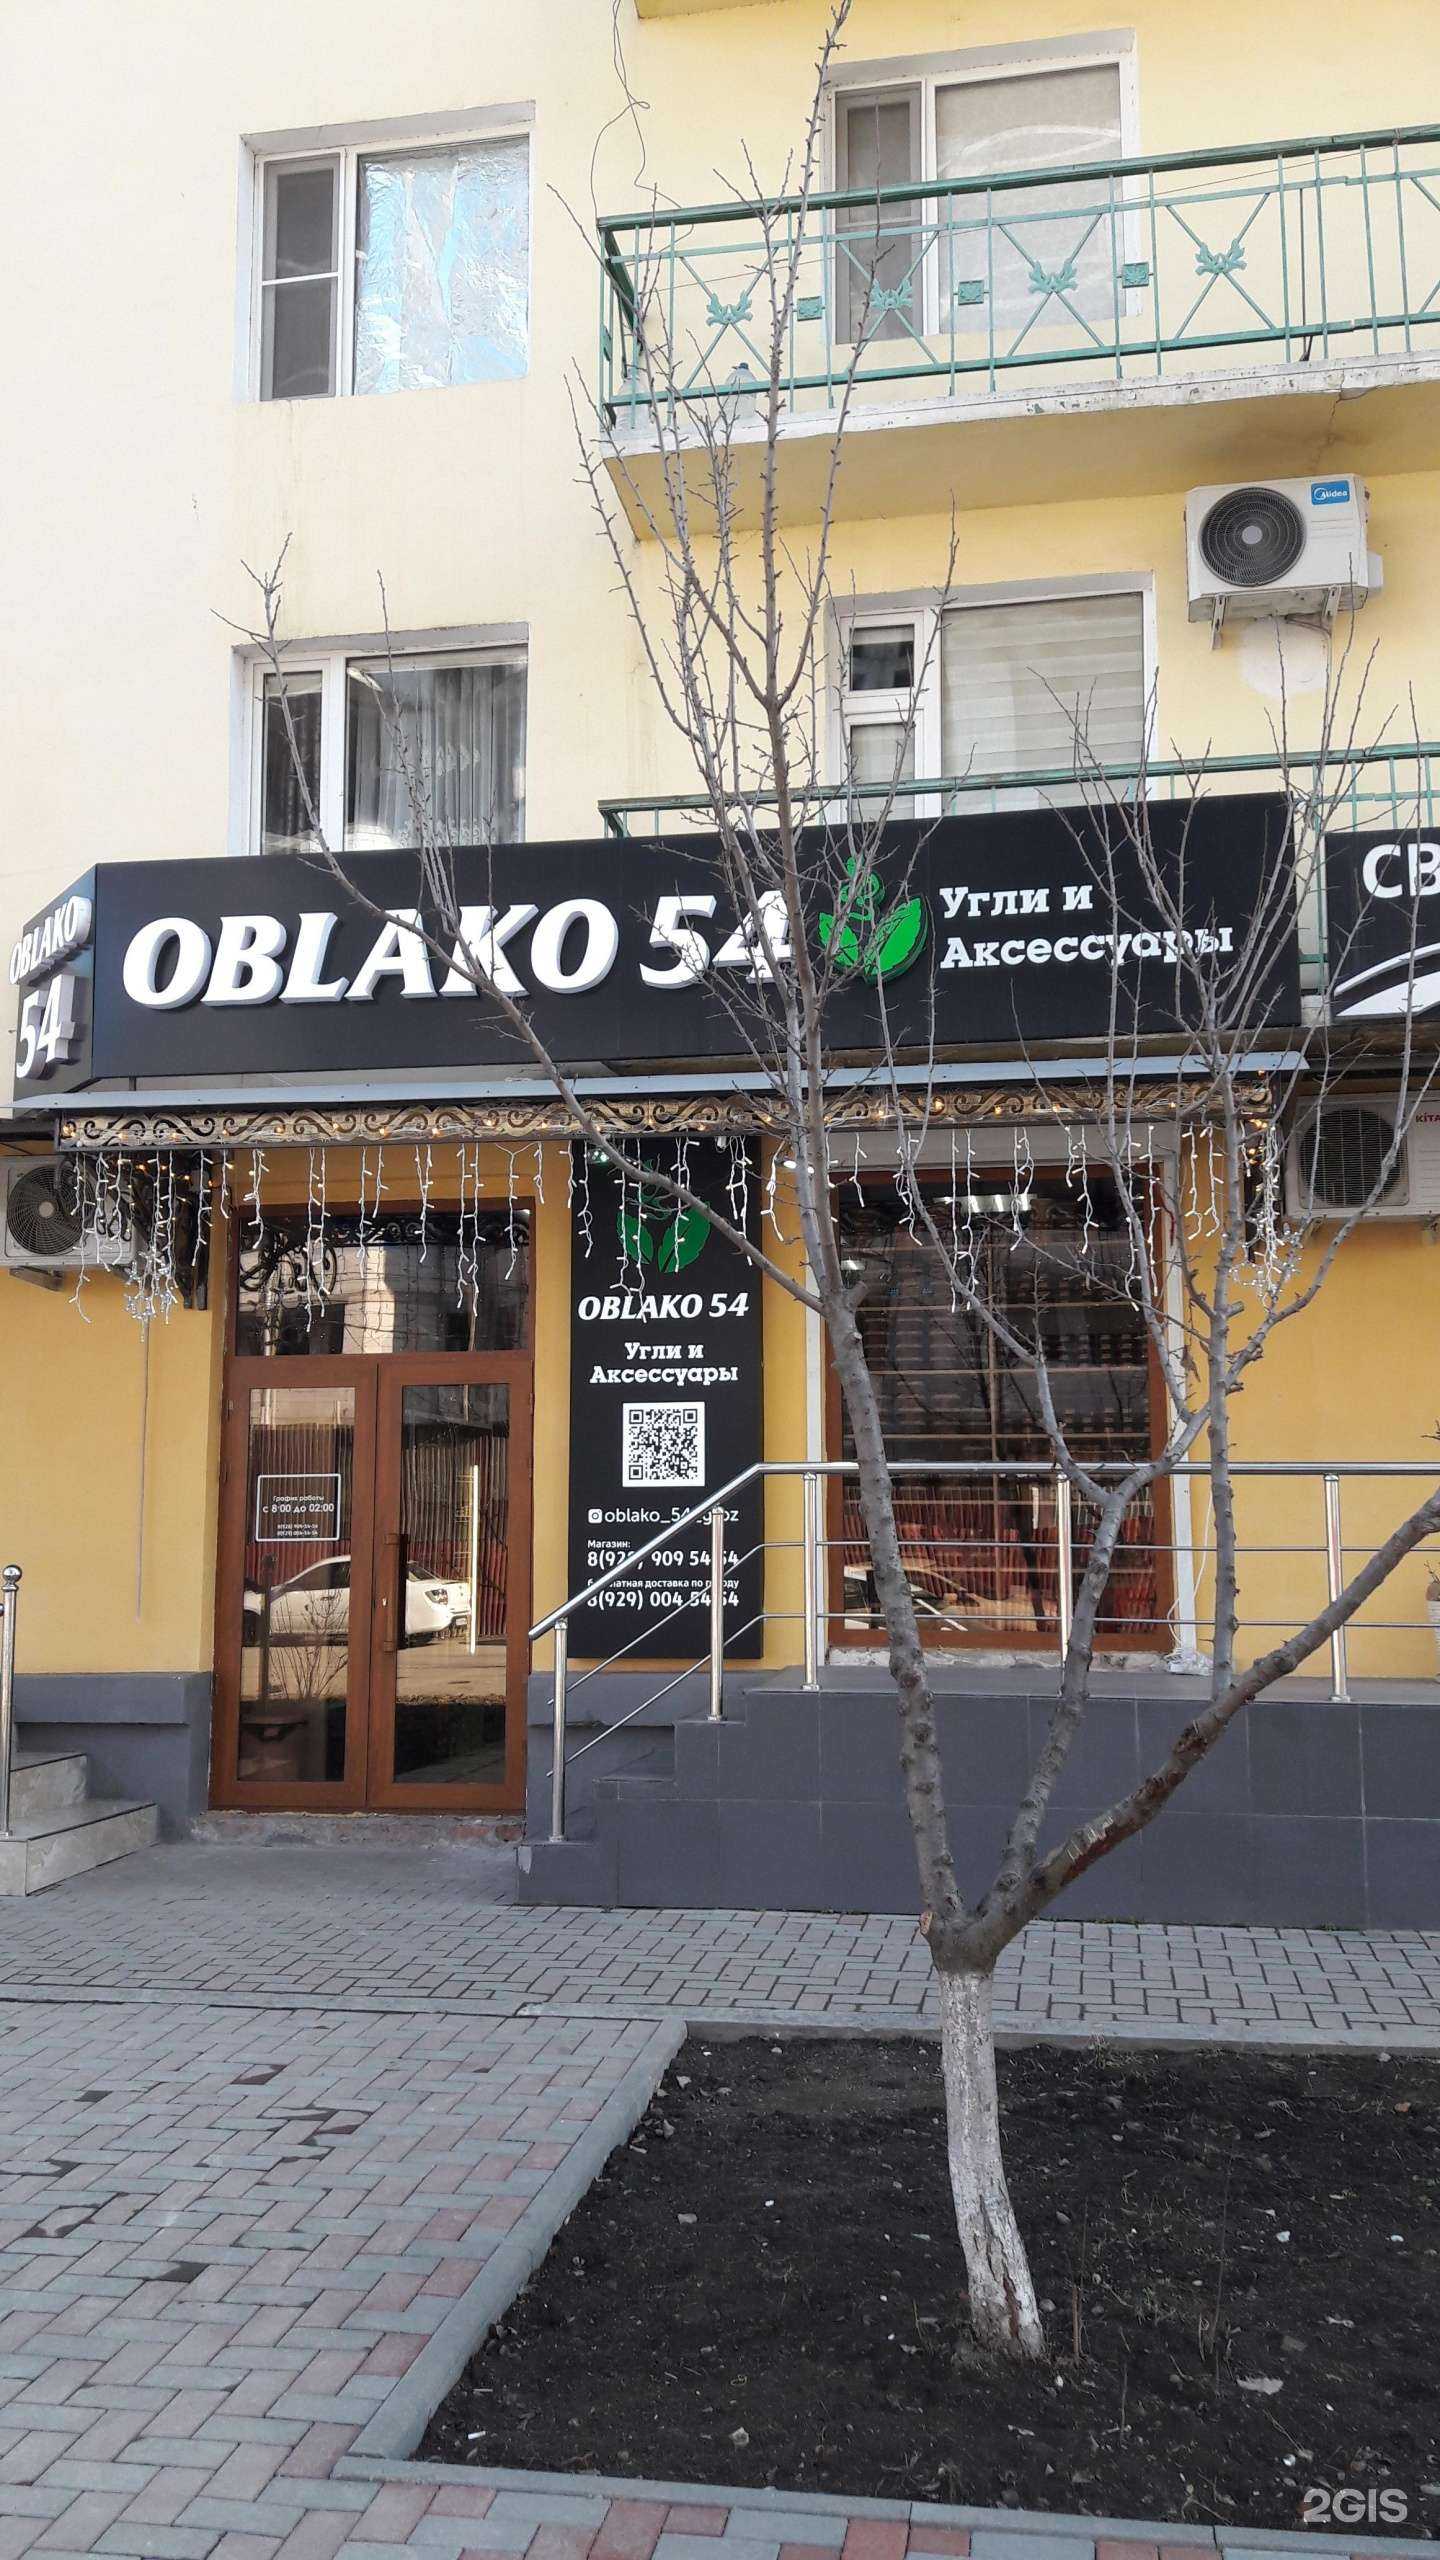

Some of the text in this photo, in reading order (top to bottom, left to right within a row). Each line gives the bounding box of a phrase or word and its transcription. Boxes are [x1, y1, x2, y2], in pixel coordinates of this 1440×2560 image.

[1316, 488, 1349, 499] Midea
[939, 885, 1093, 918] Угли и
[9, 896, 92, 985] OBLAKO
[122, 890, 798, 1010] OBLAKO 54
[940, 927, 1234, 969] Аксессуары
[16, 973, 76, 1079] 54
[577, 1292, 749, 1321] OBLAKO 54
[624, 1342, 704, 1361] Угли и
[589, 1366, 738, 1386] Аксессуары
[308, 1503, 335, 1513] 02:00
[587, 1540, 631, 1549] Магазин:
[651, 1550, 684, 1567] 909
[689, 1550, 711, 1566] 54
[644, 1580, 689, 1589] доставка
[691, 1580, 704, 1588] по
[587, 1590, 644, 1611] 8(929)
[649, 1591, 684, 1607] 004
[690, 1591, 711, 1607] 54
